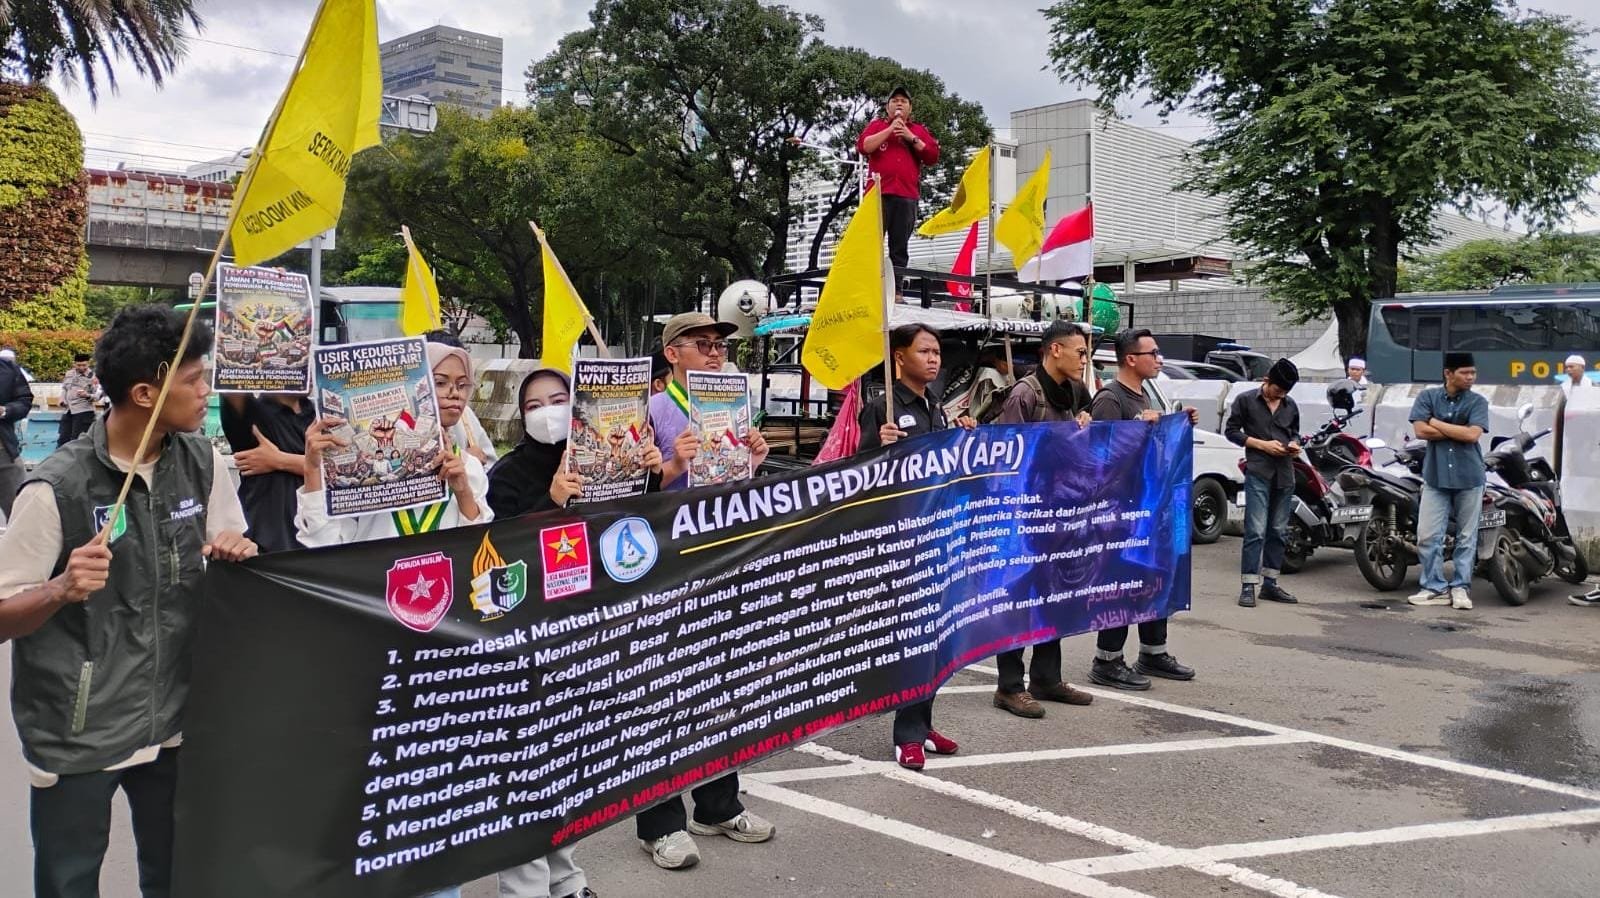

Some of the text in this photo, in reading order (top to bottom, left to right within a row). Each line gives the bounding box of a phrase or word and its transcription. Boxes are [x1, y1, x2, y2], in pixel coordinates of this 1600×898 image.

[318, 342, 422, 364] USIR KEDUBES AS
[322, 352, 422, 375] DARI TANAH AIR!
[578, 364, 619, 373] LINDUNGI
[578, 372, 649, 385] WNI SEGERA!
[331, 486, 371, 496] TINGGALKAN
[331, 494, 362, 503] PERKUAT
[364, 487, 408, 499] KEDAULATAN
[331, 498, 381, 509] PERTAHANKAN
[382, 493, 415, 502] MARTABAT
[397, 559, 421, 571] PEMUDA
[671, 434, 1025, 540] ALIANSI PEDULI IRAN (API)
[368, 752, 388, 767] 4.
[395, 728, 510, 762] Mengajak
[516, 705, 583, 740] seluruh
[587, 685, 646, 713] lapisan
[649, 649, 727, 693] masyarakat
[729, 630, 791, 660] Indonesia
[794, 617, 832, 638] untuk
[835, 598, 895, 626] melakukan
[951, 564, 966, 582] total
[967, 559, 1007, 575] terhadap
[1009, 554, 1047, 565] seluruh
[1049, 547, 1084, 562] produk
[1084, 543, 1104, 557] yang
[1106, 536, 1150, 550] terafiliasi
[371, 699, 542, 742] menghentikan
[544, 672, 613, 708] eskalasi
[616, 651, 665, 685] konflik
[667, 635, 718, 663] dengan
[719, 604, 808, 646] negara-negara
[811, 593, 845, 613] timur
[846, 581, 888, 603] tengah,
[891, 566, 935, 590] termasuk
[960, 544, 1000, 561] Palestina.
[376, 699, 397, 715] 3.
[413, 679, 531, 709] Menuntut
[541, 649, 620, 687] Kedutaan
[629, 630, 670, 656] Besar
[676, 609, 733, 639] Amerika
[739, 590, 783, 615] Serikat
[790, 581, 817, 601] agar
[824, 558, 911, 590] menyampaikan
[914, 546, 941, 566] pesan
[970, 527, 1010, 542] Presiden
[1017, 523, 1056, 535] Donald
[1063, 519, 1087, 532] Trump
[1091, 512, 1117, 525] untuk
[1121, 509, 1151, 521] segera
[381, 506, 1077, 690] 2. mendesak Menteri Luar Negeri RI untuk menutup dan mengusir Kantor Amerika Serikat dari
[388, 494, 1043, 665] 1. mendesak Menteri Luar Negeri RI untuk segera memutus hubungan Amerika Serikat.
[355, 681, 858, 876] hormuz untuk menjaga stabilitas pasokan energi dalam negeri.
[357, 579, 1143, 847] 6. Mendesak Menteri Luar Negeri RI untuk melakukan diplomasi atas termasuk BBM untuk dapat melewati selat
[361, 587, 1009, 822] 5. Mendesak Menteri Luar Negeri RI untuk segera melakukan evakuasi WNI di konflik.
[364, 602, 941, 795] dengan Amerika Serikat sebagai bentuk sanksi ekonomi atas tindakan mereka
[551, 799, 630, 847] #PEMUDA
[632, 765, 704, 808] MUSLIMIN
[705, 757, 729, 776] DKI
[730, 731, 792, 771] JAKARTA
[805, 711, 846, 735] SEMMI
[847, 694, 901, 721] JAKARTA
[902, 683, 933, 702] RAYA
